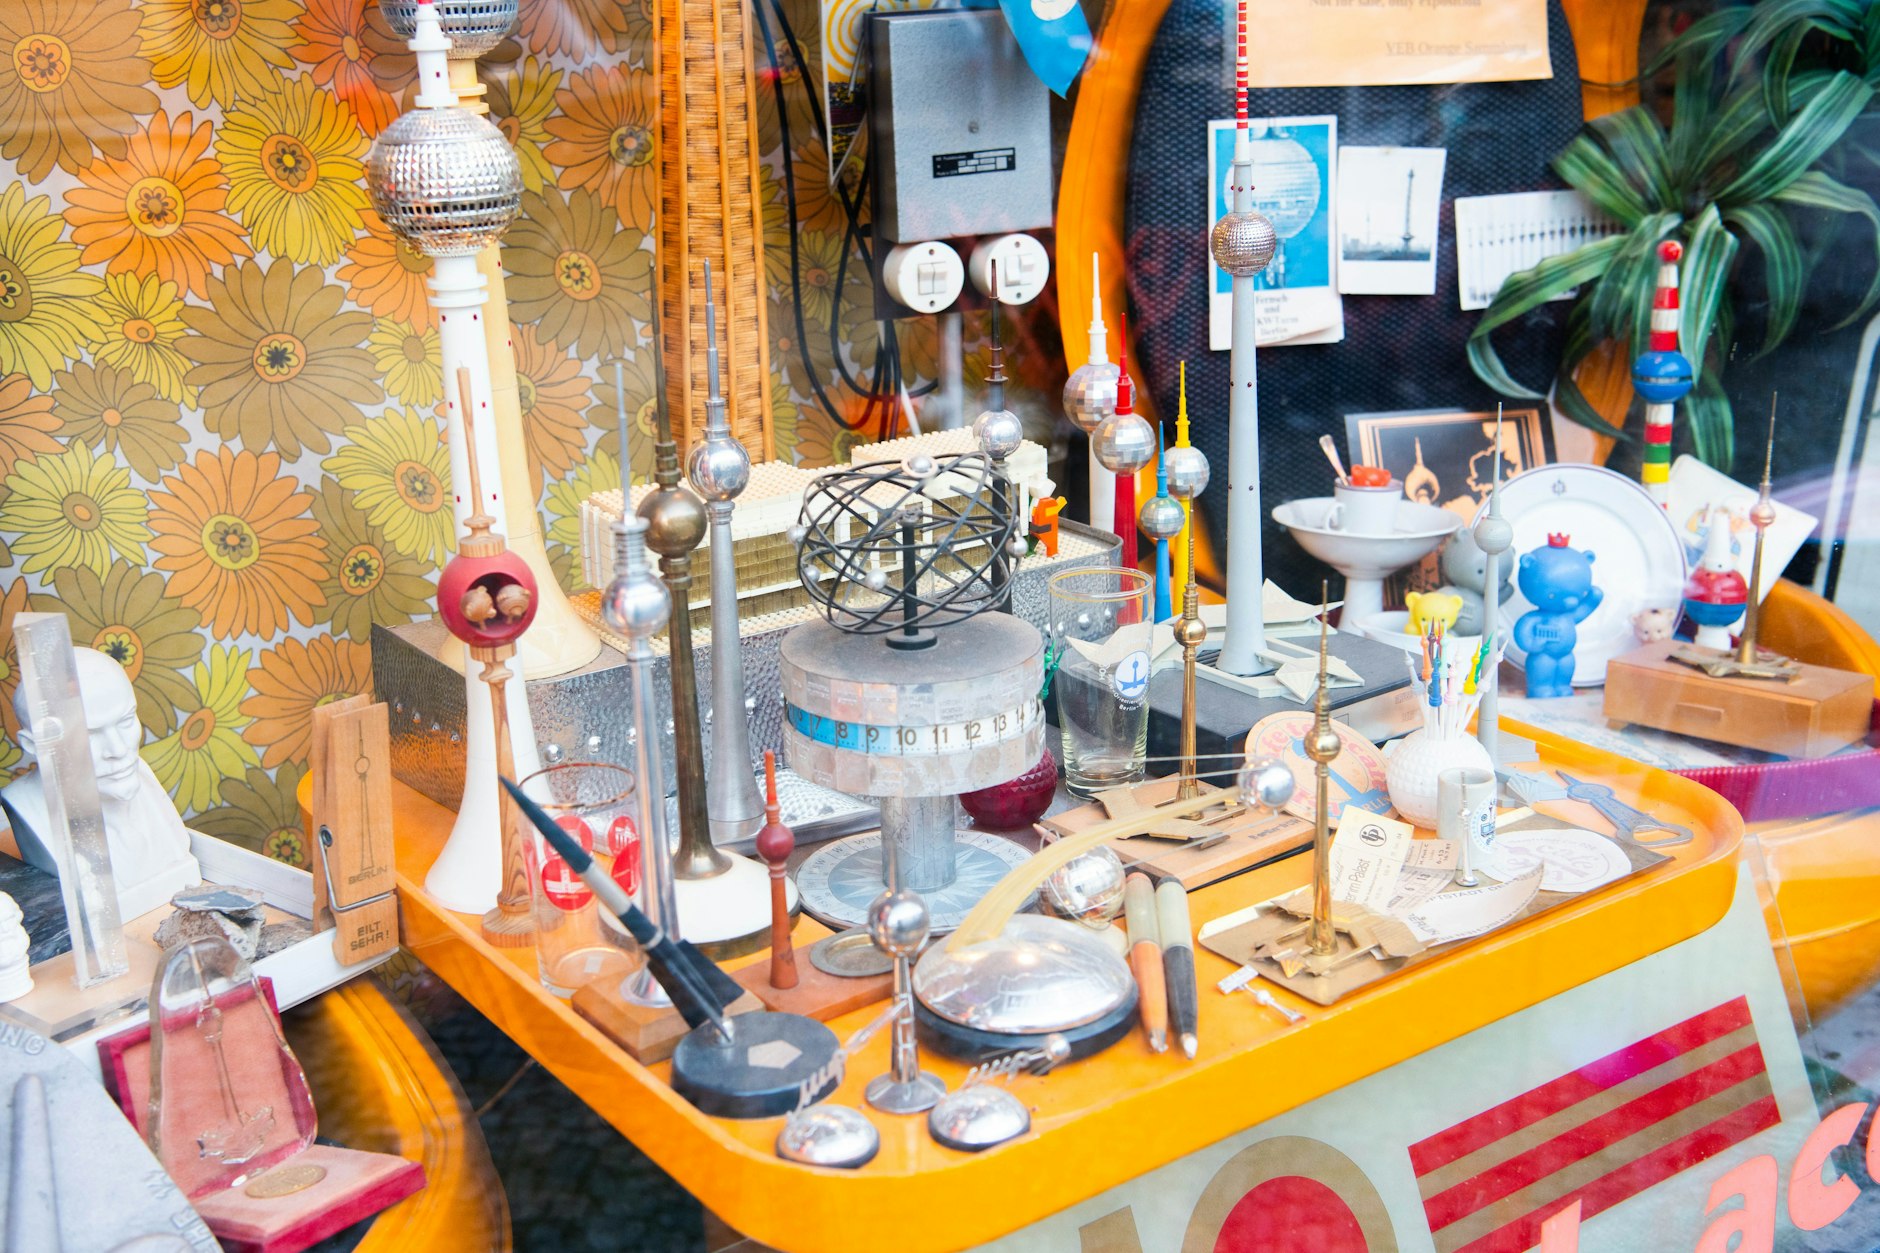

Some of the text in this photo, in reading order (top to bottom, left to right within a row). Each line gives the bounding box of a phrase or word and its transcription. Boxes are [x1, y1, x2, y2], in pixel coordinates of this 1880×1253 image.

[838, 722, 848, 739] 8
[867, 727, 879, 743] 9
[896, 728, 917, 746] 10
[933, 727, 949, 744] 11
[964, 722, 981, 740] 12
[992, 715, 1007, 733] 13
[348, 864, 389, 886] BERLIN
[357, 920, 382, 938] EILT
